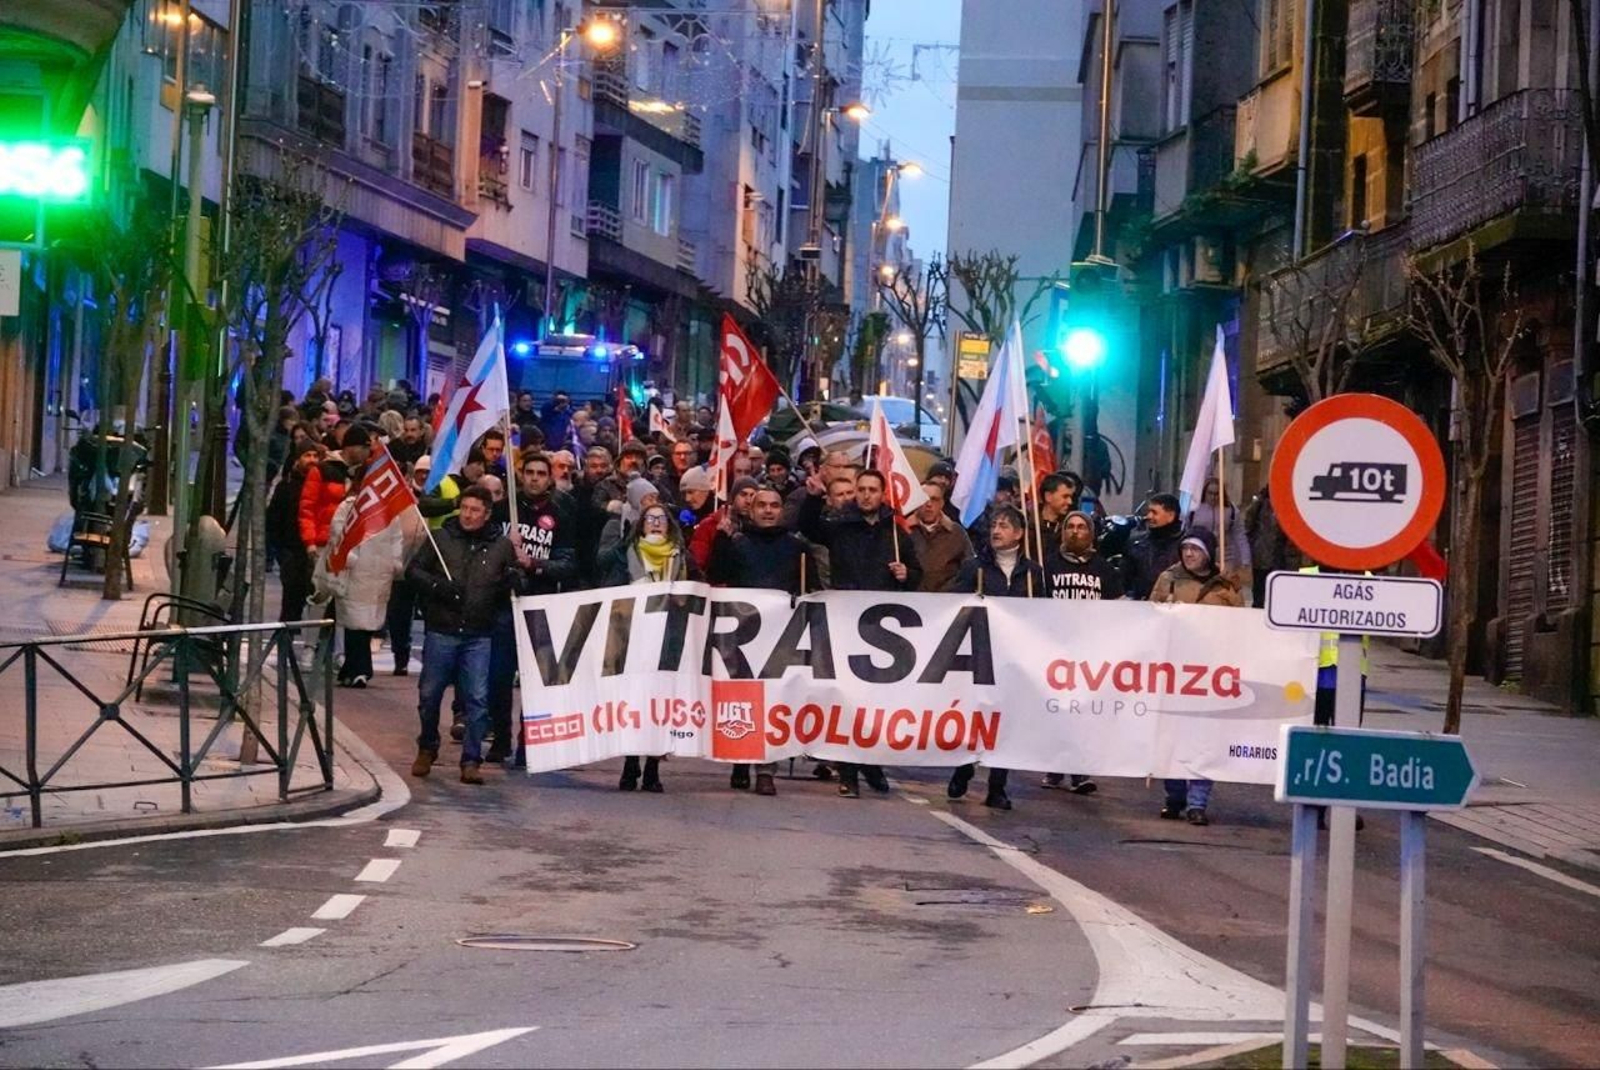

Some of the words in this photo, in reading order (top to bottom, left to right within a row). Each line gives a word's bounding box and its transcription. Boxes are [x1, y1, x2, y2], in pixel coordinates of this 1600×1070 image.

[1350, 468, 1395, 491] 10t
[1052, 573, 1101, 590] VITRASA
[1333, 582, 1374, 601] AGÁS
[1297, 608, 1407, 628] AUTORIZADOS
[523, 593, 996, 687] VITRASA
[1046, 658, 1242, 698] avanza
[1046, 698, 1148, 717] GRUPO
[527, 719, 581, 740] CCOO
[716, 702, 752, 723] UGT
[765, 699, 1002, 752] SOLUCIÓN
[670, 729, 694, 739] igo
[1229, 745, 1278, 761] HORARIOS
[1370, 753, 1434, 790] Badia
